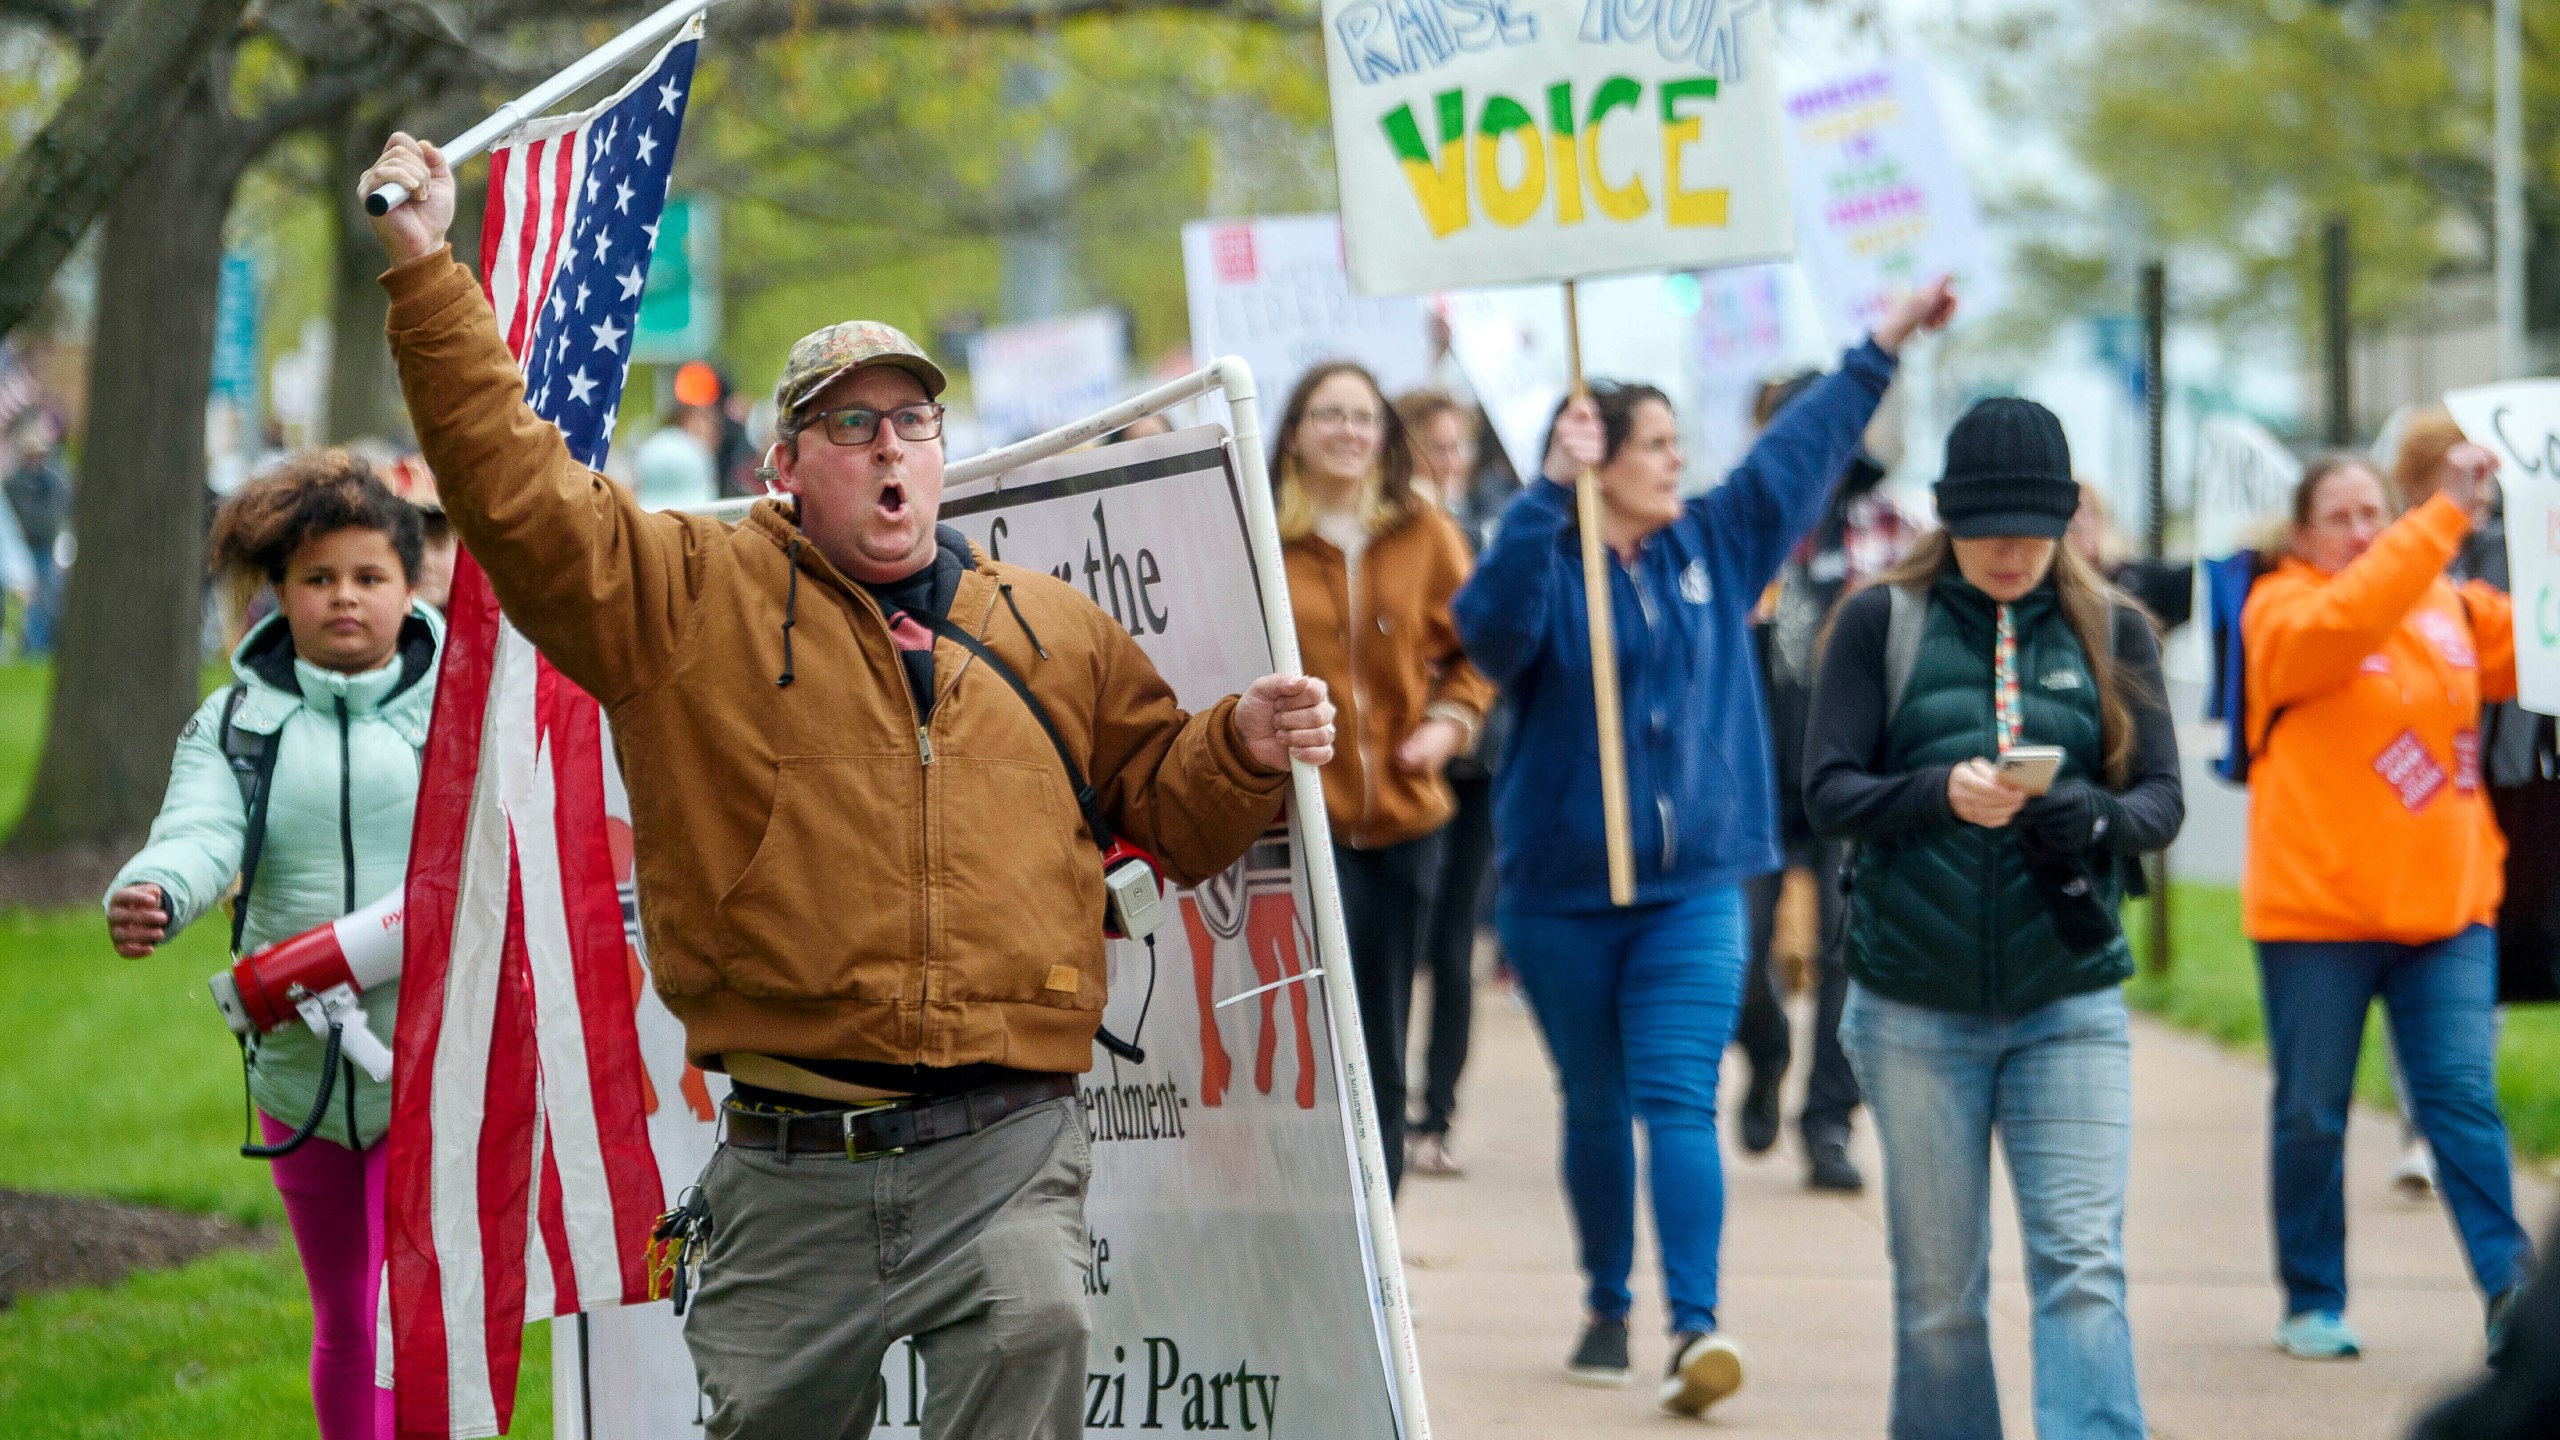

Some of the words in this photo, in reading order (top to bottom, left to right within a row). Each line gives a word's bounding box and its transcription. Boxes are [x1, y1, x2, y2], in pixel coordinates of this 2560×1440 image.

[1377, 76, 1729, 240] VOICE
[1083, 497, 1169, 636] the
[1140, 1337, 1280, 1440] Party
